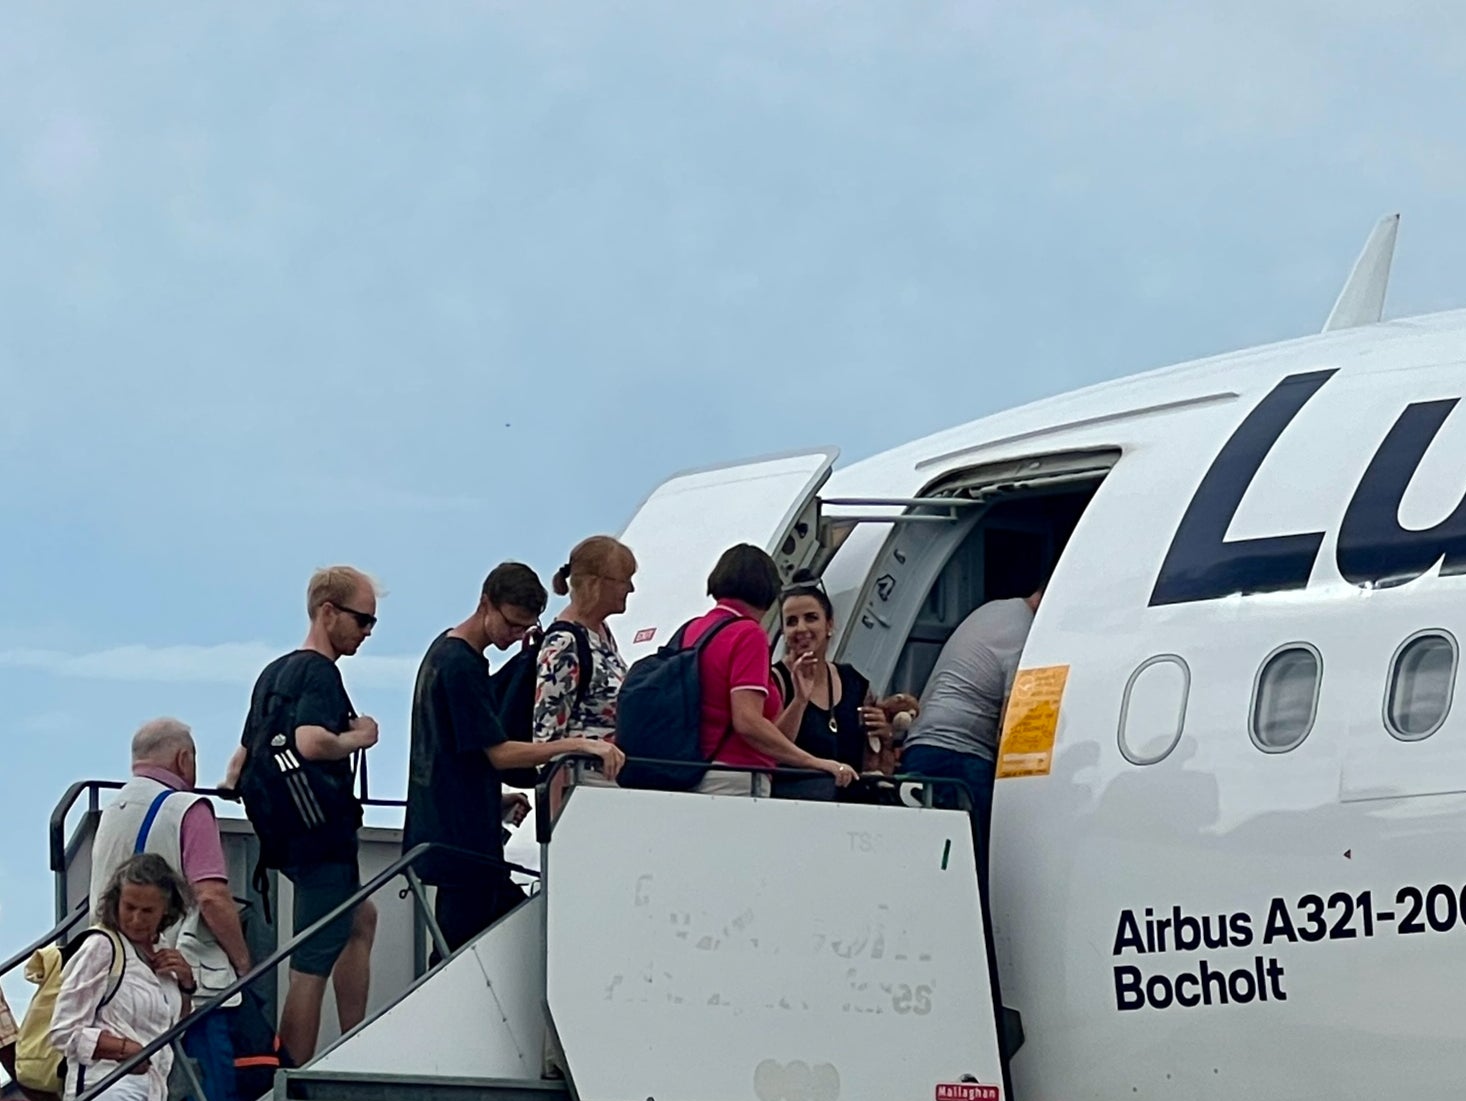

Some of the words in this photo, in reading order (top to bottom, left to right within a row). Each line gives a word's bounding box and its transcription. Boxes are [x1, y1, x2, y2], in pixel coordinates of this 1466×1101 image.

[1113, 906, 1253, 955] Airbus
[1113, 956, 1287, 1011] Bocholt
[938, 1086, 996, 1100] Mallaghan
